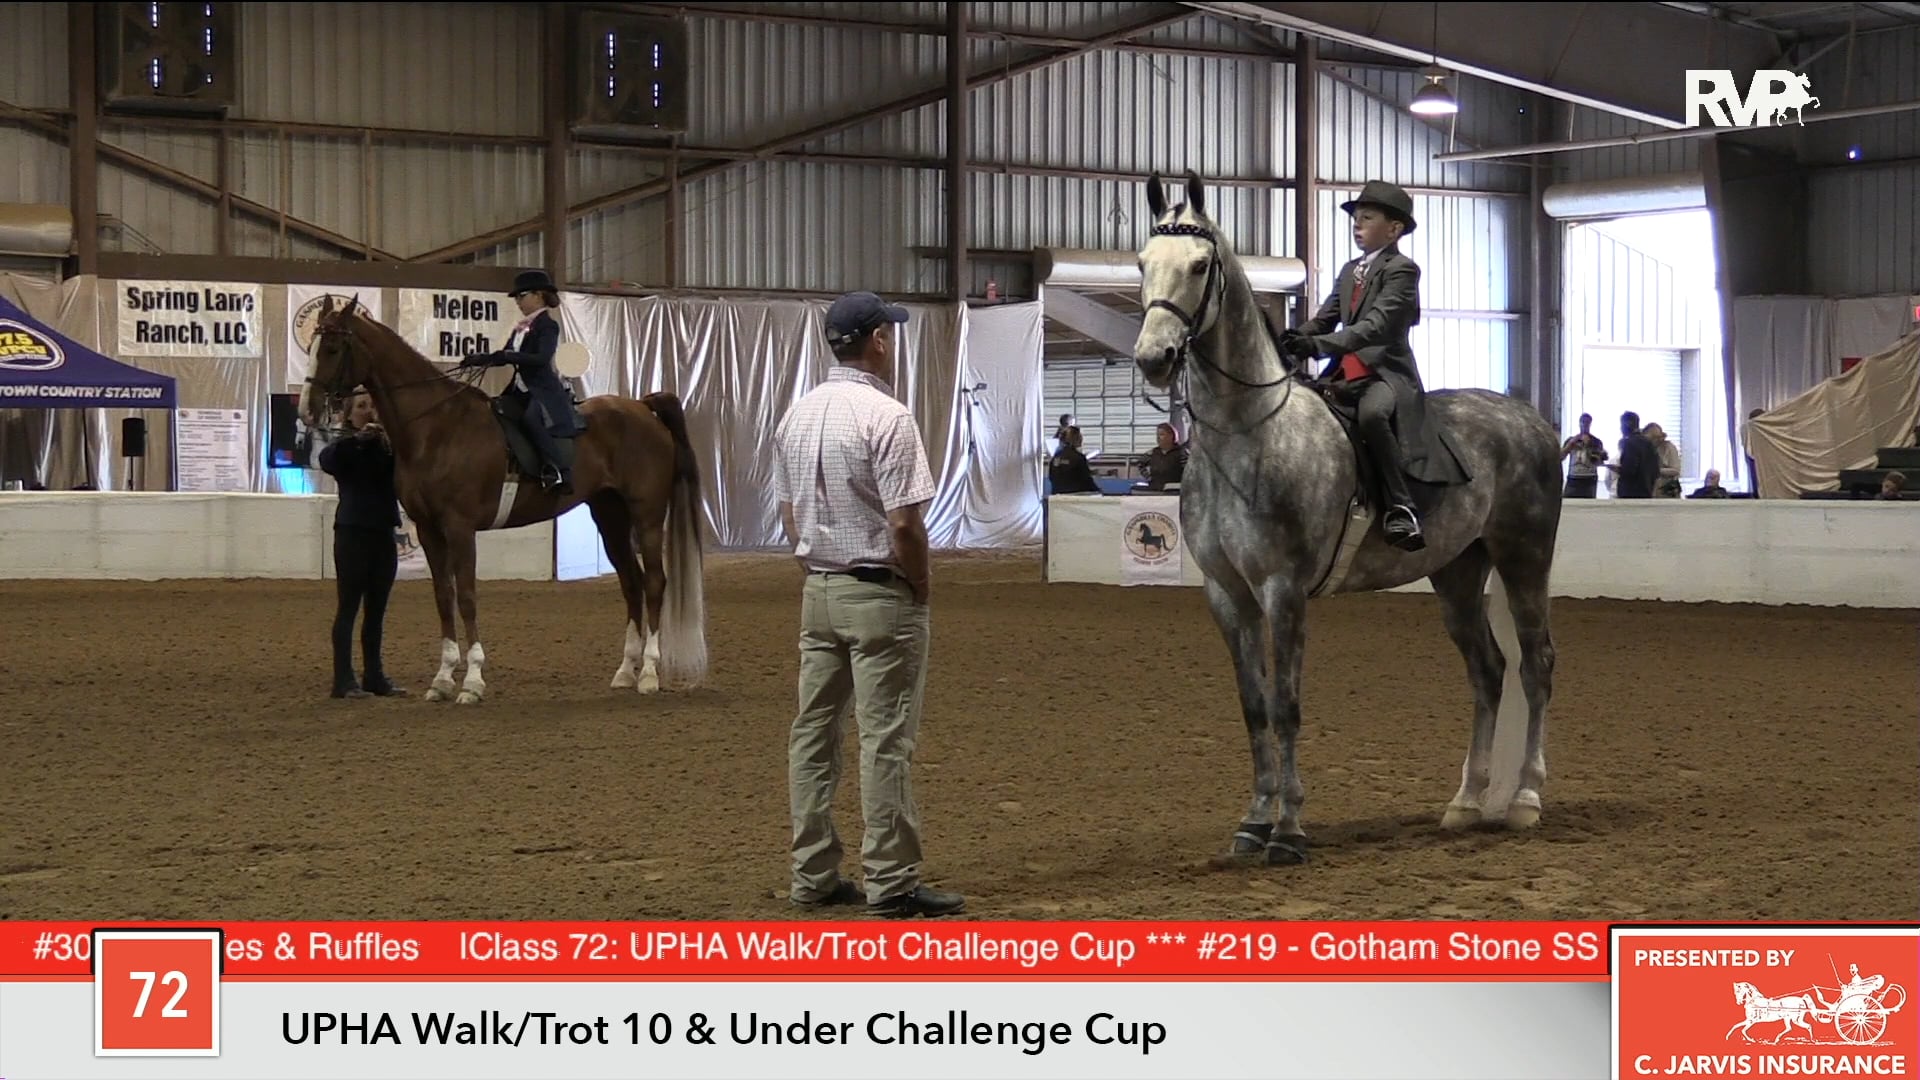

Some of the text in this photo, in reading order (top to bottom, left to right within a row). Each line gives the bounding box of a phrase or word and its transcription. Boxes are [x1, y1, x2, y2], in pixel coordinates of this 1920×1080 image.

[127, 286, 253, 313] Spring Lane
[433, 294, 498, 321] Helen
[136, 320, 247, 346] Ranch, LLC
[440, 331, 490, 357] Rich
[40, 386, 103, 398] COUNTRY
[104, 387, 163, 399] STATION
